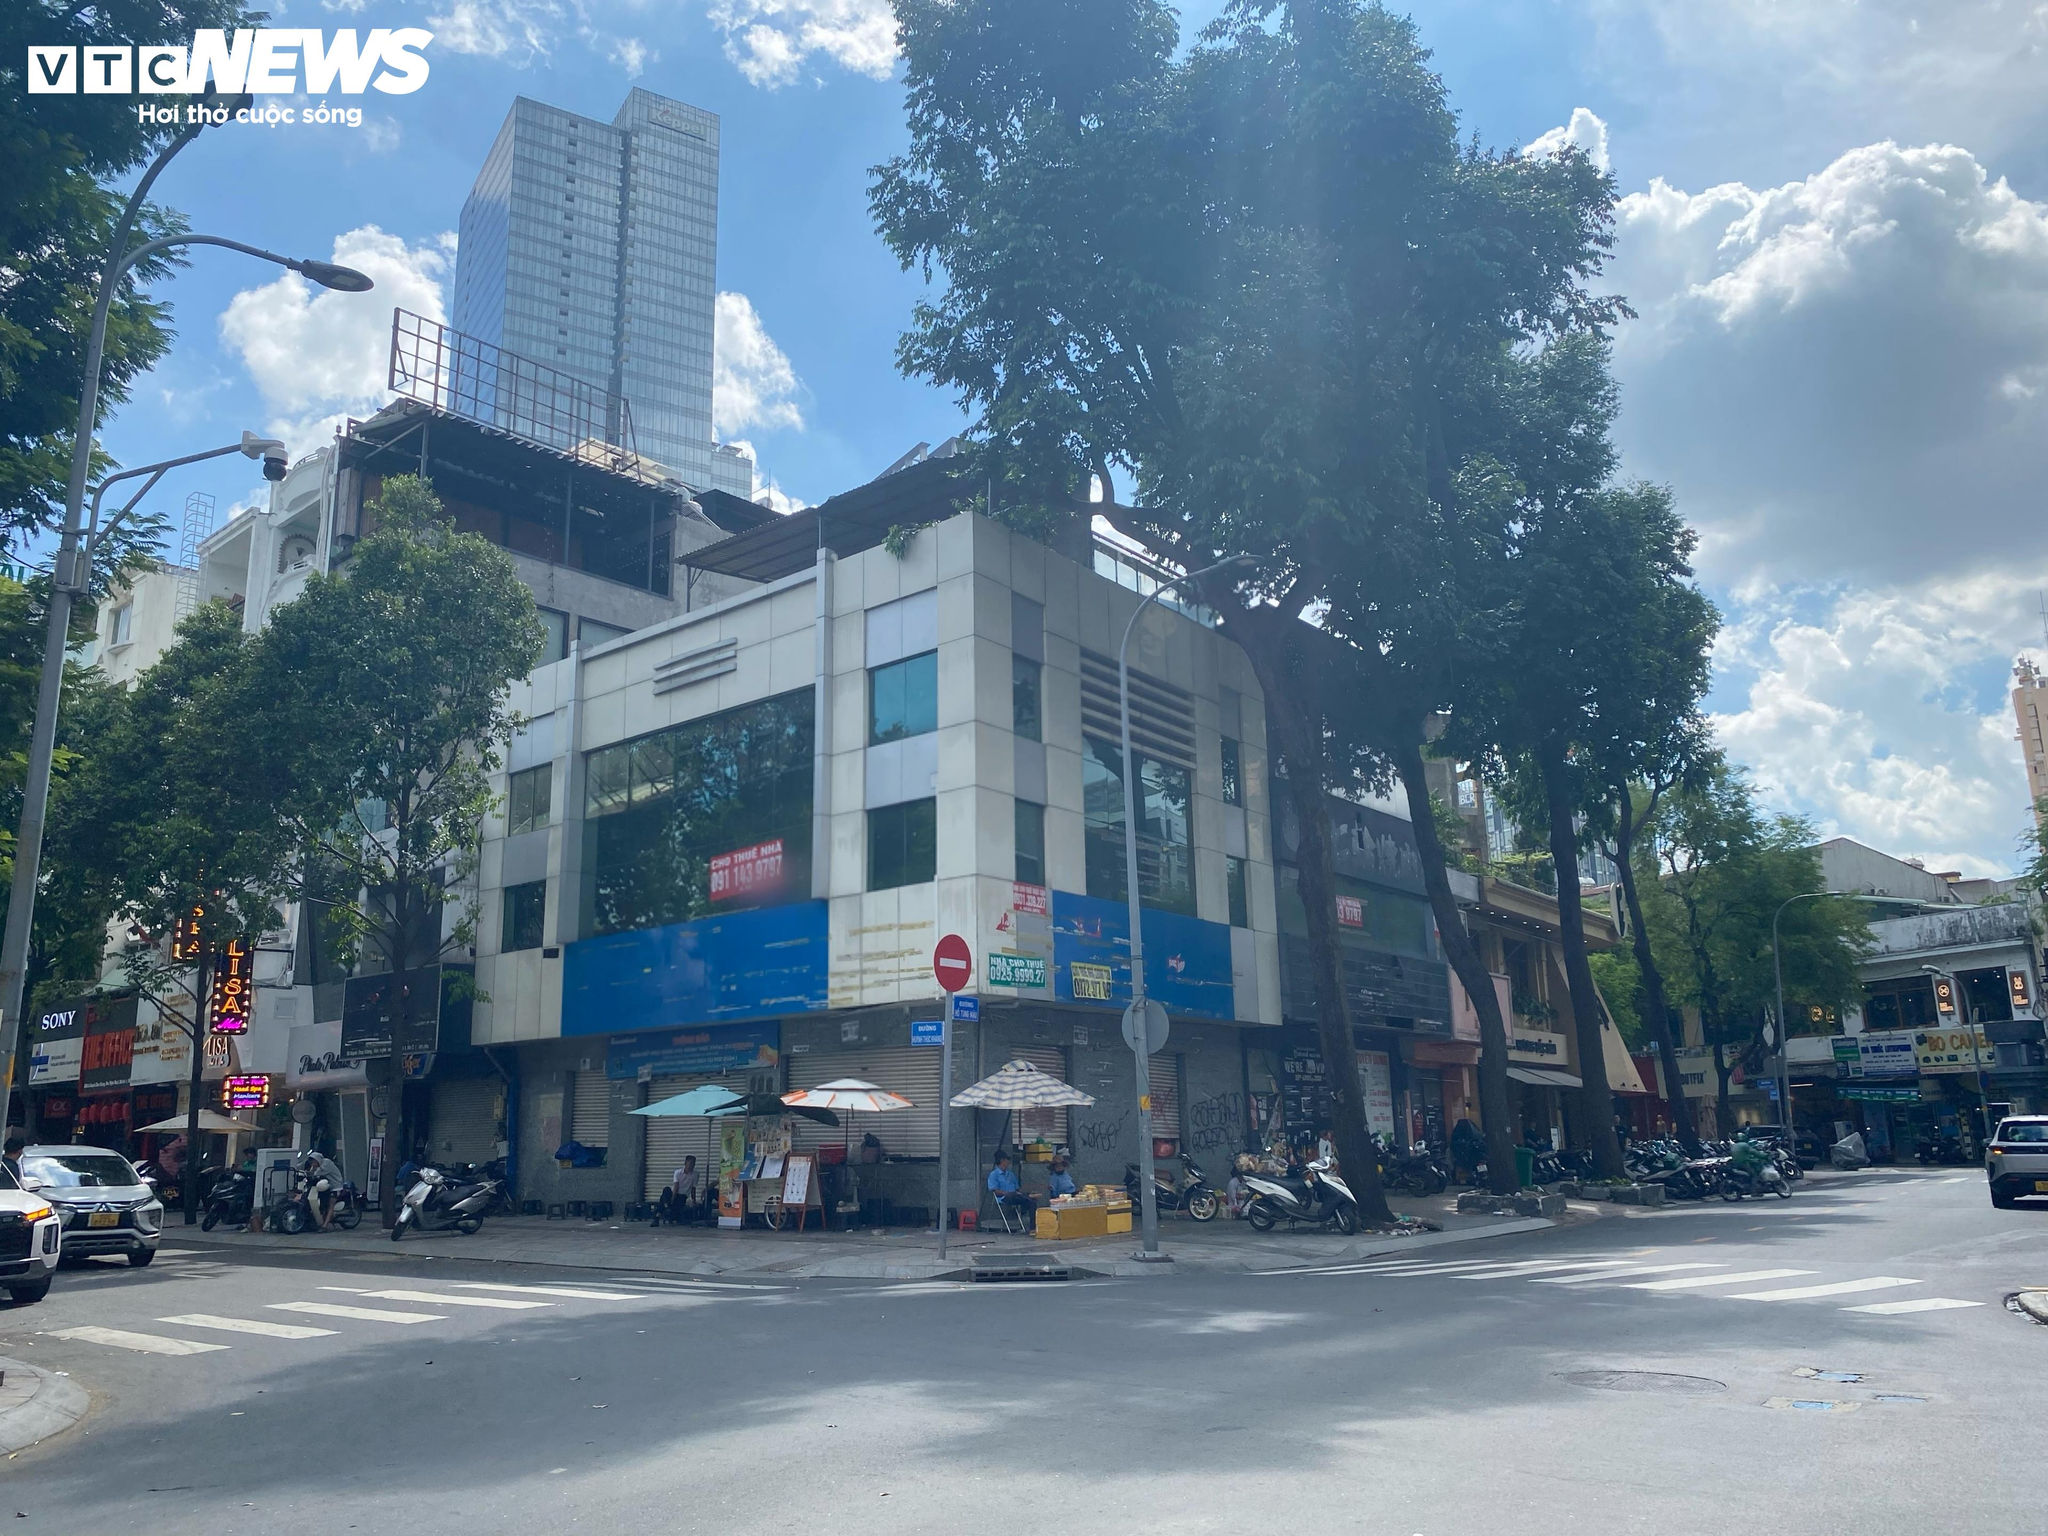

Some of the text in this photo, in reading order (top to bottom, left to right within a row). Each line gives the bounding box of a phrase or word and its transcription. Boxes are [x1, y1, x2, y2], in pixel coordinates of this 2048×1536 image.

[734, 847, 758, 864] THUÊ
[761, 840, 782, 857] NHÀ
[990, 956, 1044, 968] NHÀ CHO THUÊ
[220, 940, 244, 1013] LISA
[990, 966, 1045, 984] 0925.9999.27
[41, 1010, 76, 1030] SONY
